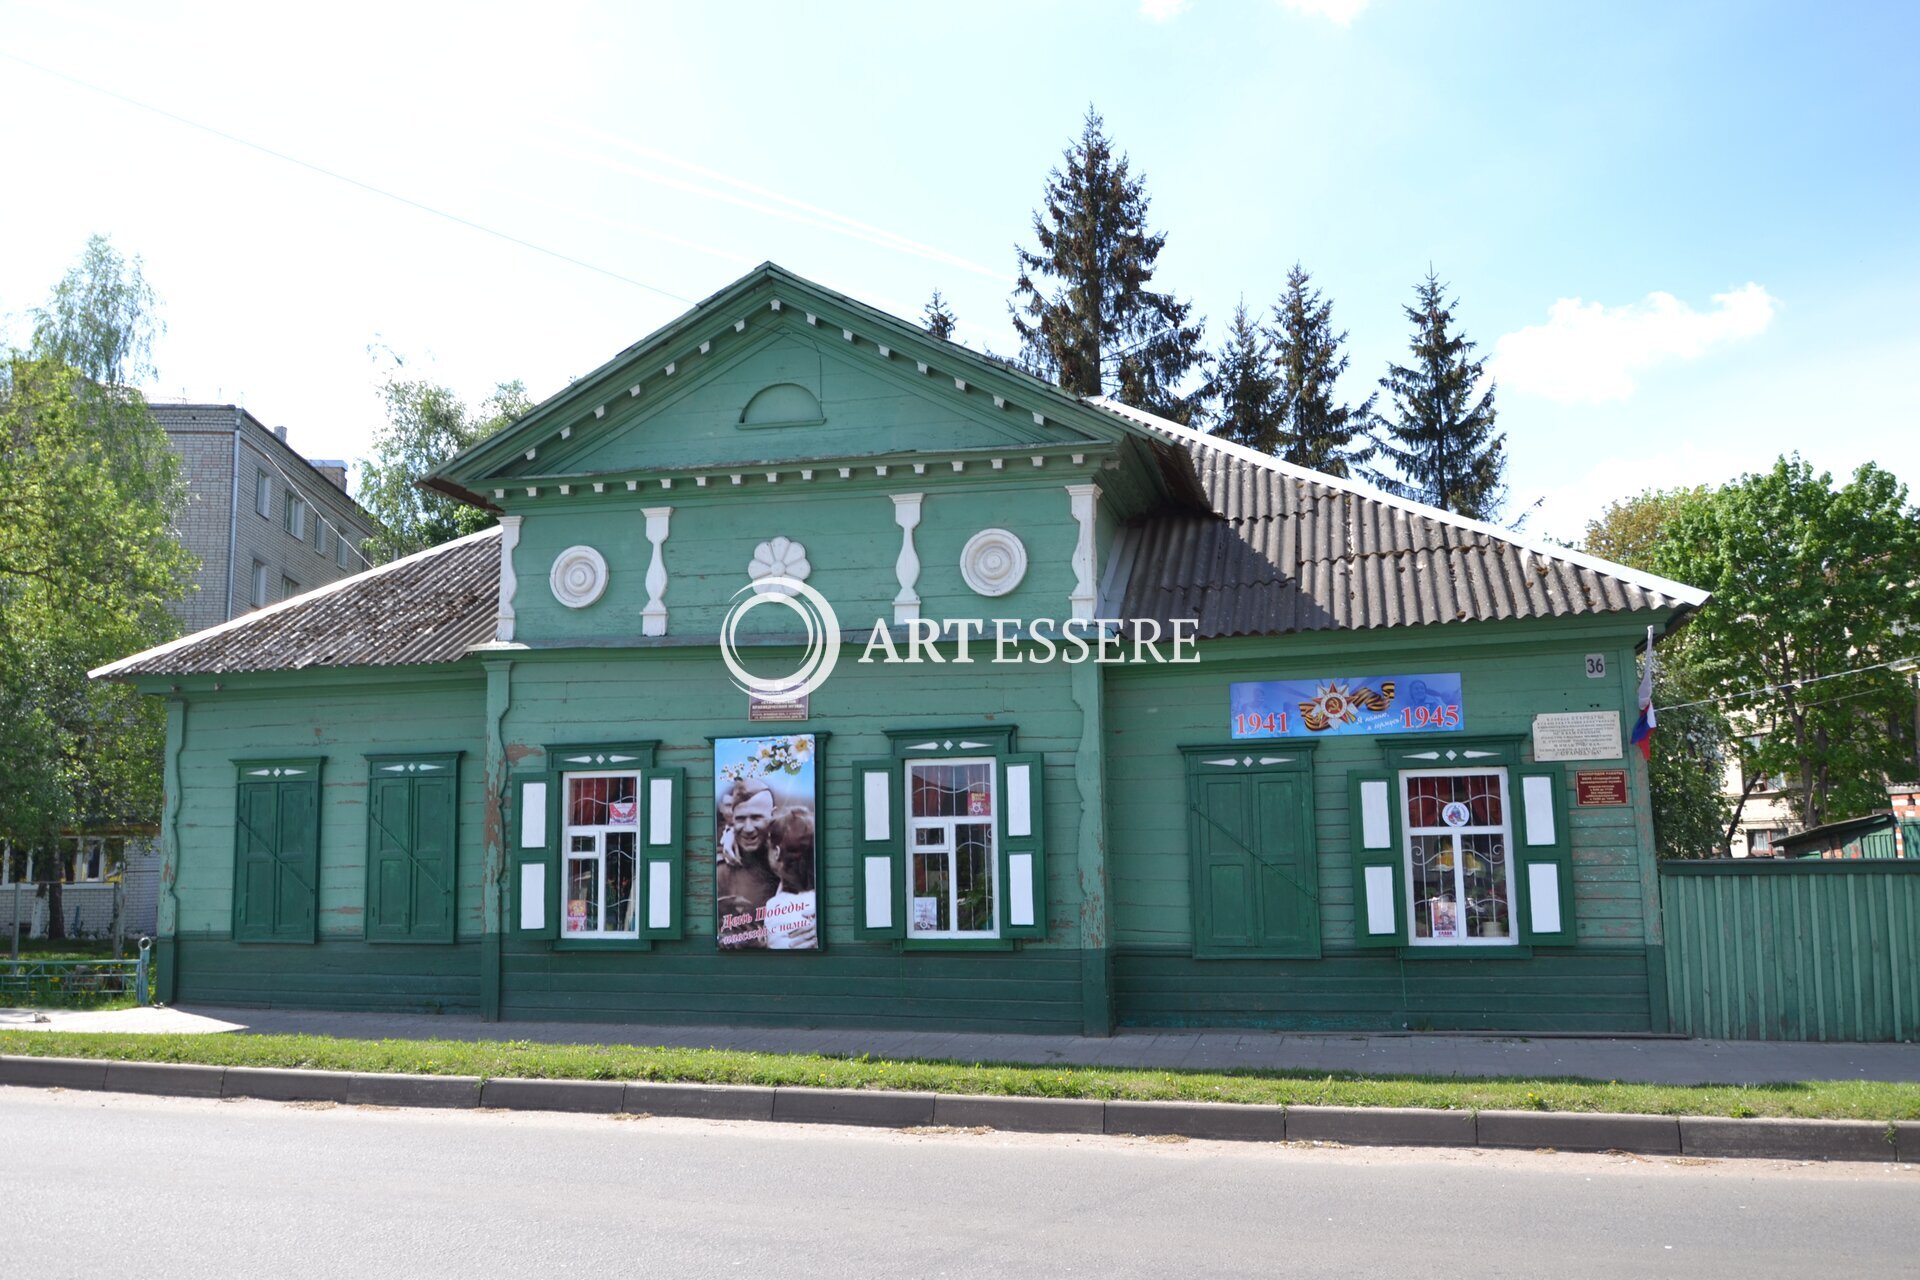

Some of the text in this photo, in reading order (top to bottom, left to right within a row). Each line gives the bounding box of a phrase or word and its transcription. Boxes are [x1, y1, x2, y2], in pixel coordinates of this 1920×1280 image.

[1587, 658, 1604, 674] 36
[1234, 711, 1290, 735] 1941
[1401, 704, 1460, 729] 1945
[720, 912, 753, 932] День
